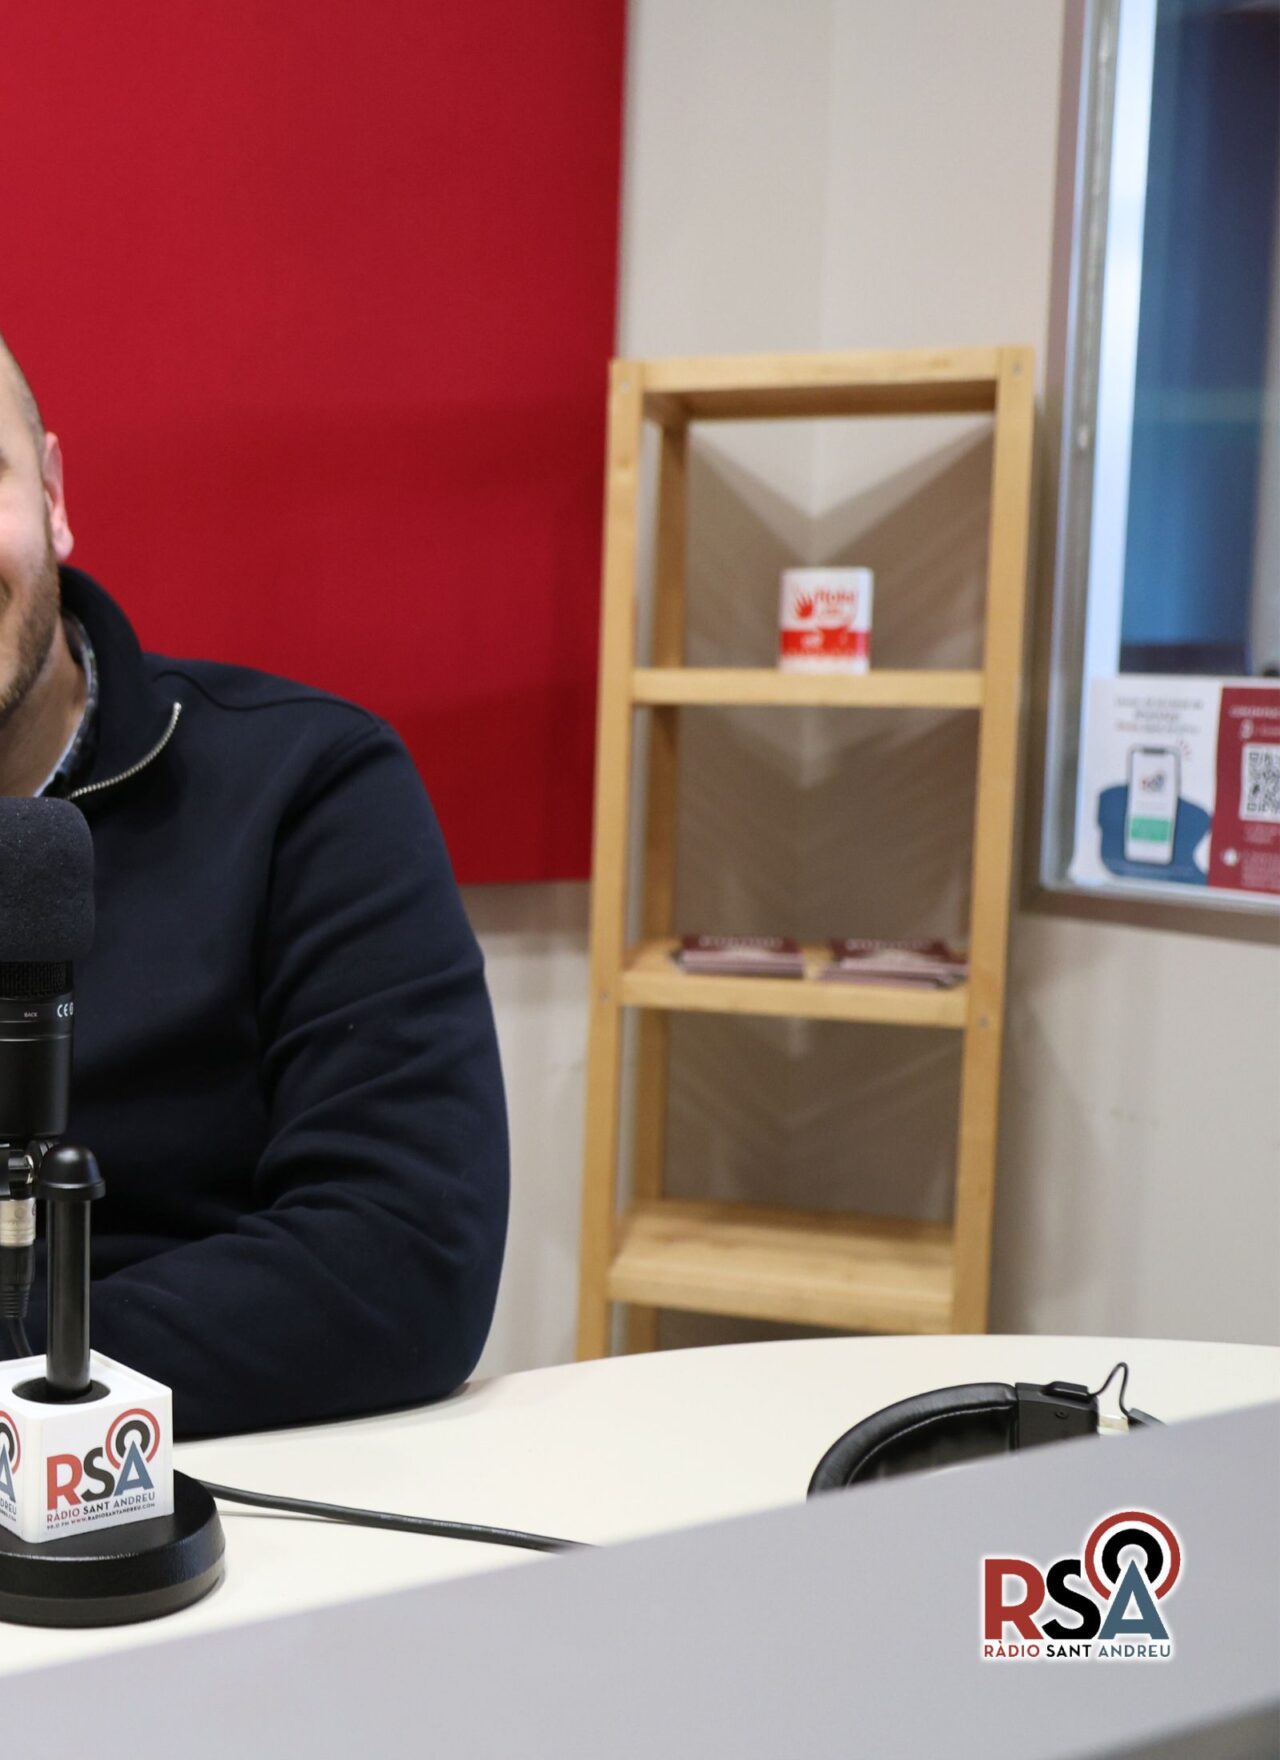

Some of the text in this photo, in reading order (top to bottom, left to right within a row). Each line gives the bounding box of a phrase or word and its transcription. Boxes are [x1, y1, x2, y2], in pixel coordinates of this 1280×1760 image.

[47, 1439, 155, 1510] RSA
[83, 1501, 111, 1516] SANT
[113, 1491, 156, 1509] ANDREU
